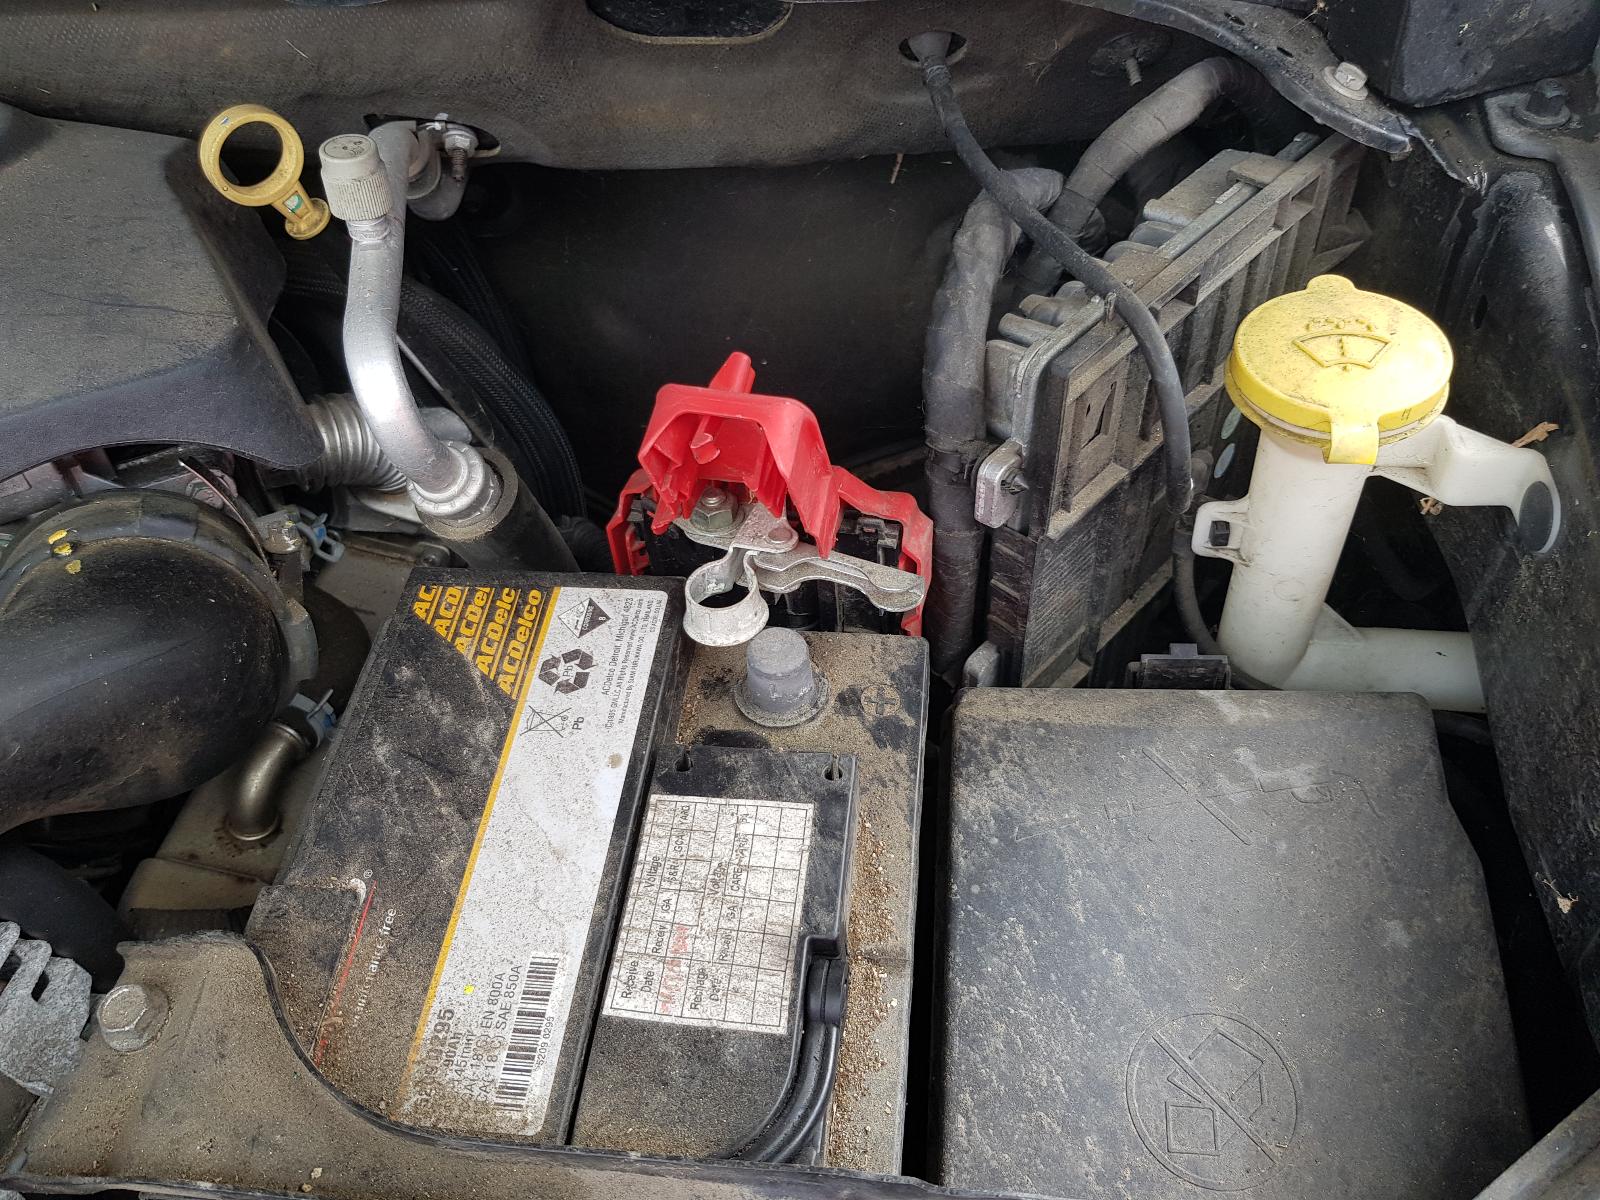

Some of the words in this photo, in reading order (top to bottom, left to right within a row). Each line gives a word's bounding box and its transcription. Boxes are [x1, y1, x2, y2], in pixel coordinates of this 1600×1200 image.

[412, 584, 436, 619] AC
[432, 586, 462, 637] ACD
[453, 586, 490, 654] ACDel
[474, 587, 517, 675] ACDelc
[496, 589, 543, 694] ACDelco
[562, 665, 573, 676] Pb
[600, 668, 615, 695] ACDelco
[571, 716, 584, 730] Pb
[643, 855, 662, 888] Voltage
[729, 866, 743, 891] CARE
[378, 907, 396, 935] free
[486, 972, 506, 1005] 800A
[503, 965, 522, 998] 850A
[620, 960, 638, 999] Receive
[640, 970, 654, 992] Date
[689, 966, 709, 1010] Rechage
[480, 1010, 495, 1028] EN
[495, 1002, 512, 1030] SAE
[542, 1015, 554, 1039] 0295
[441, 1031, 462, 1067] 90Ah
